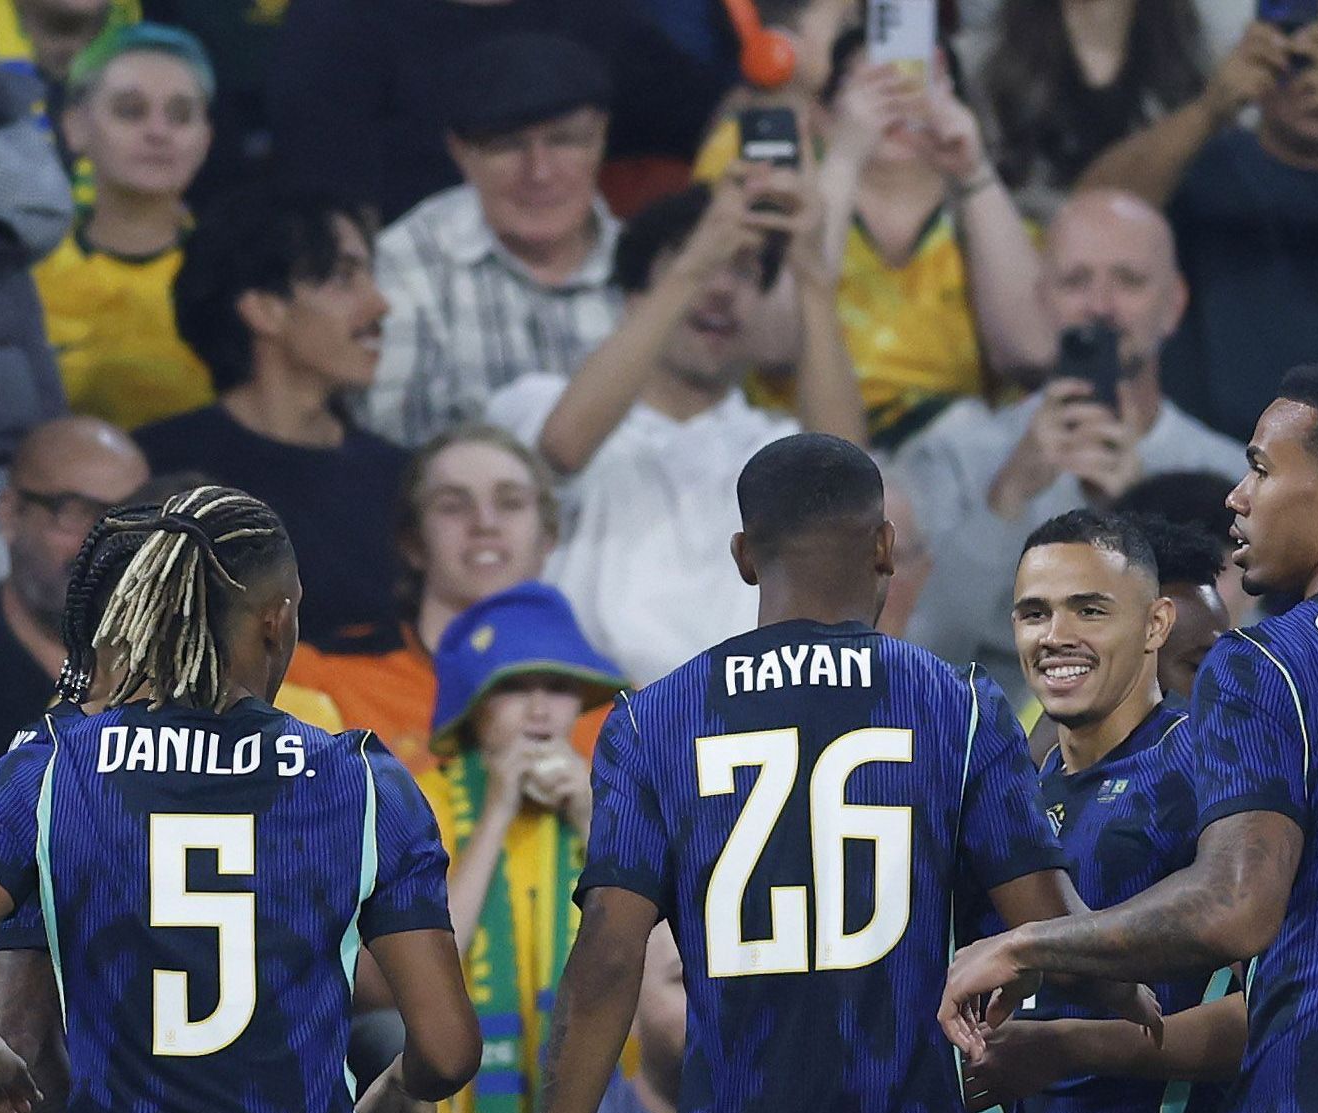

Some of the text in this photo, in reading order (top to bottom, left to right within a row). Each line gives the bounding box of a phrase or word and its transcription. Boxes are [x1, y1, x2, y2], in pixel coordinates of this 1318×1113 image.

[725, 644, 872, 696] RAYAN
[97, 726, 317, 778] DANILO S.
[695, 727, 913, 978] 26
[150, 813, 257, 1057] 5
